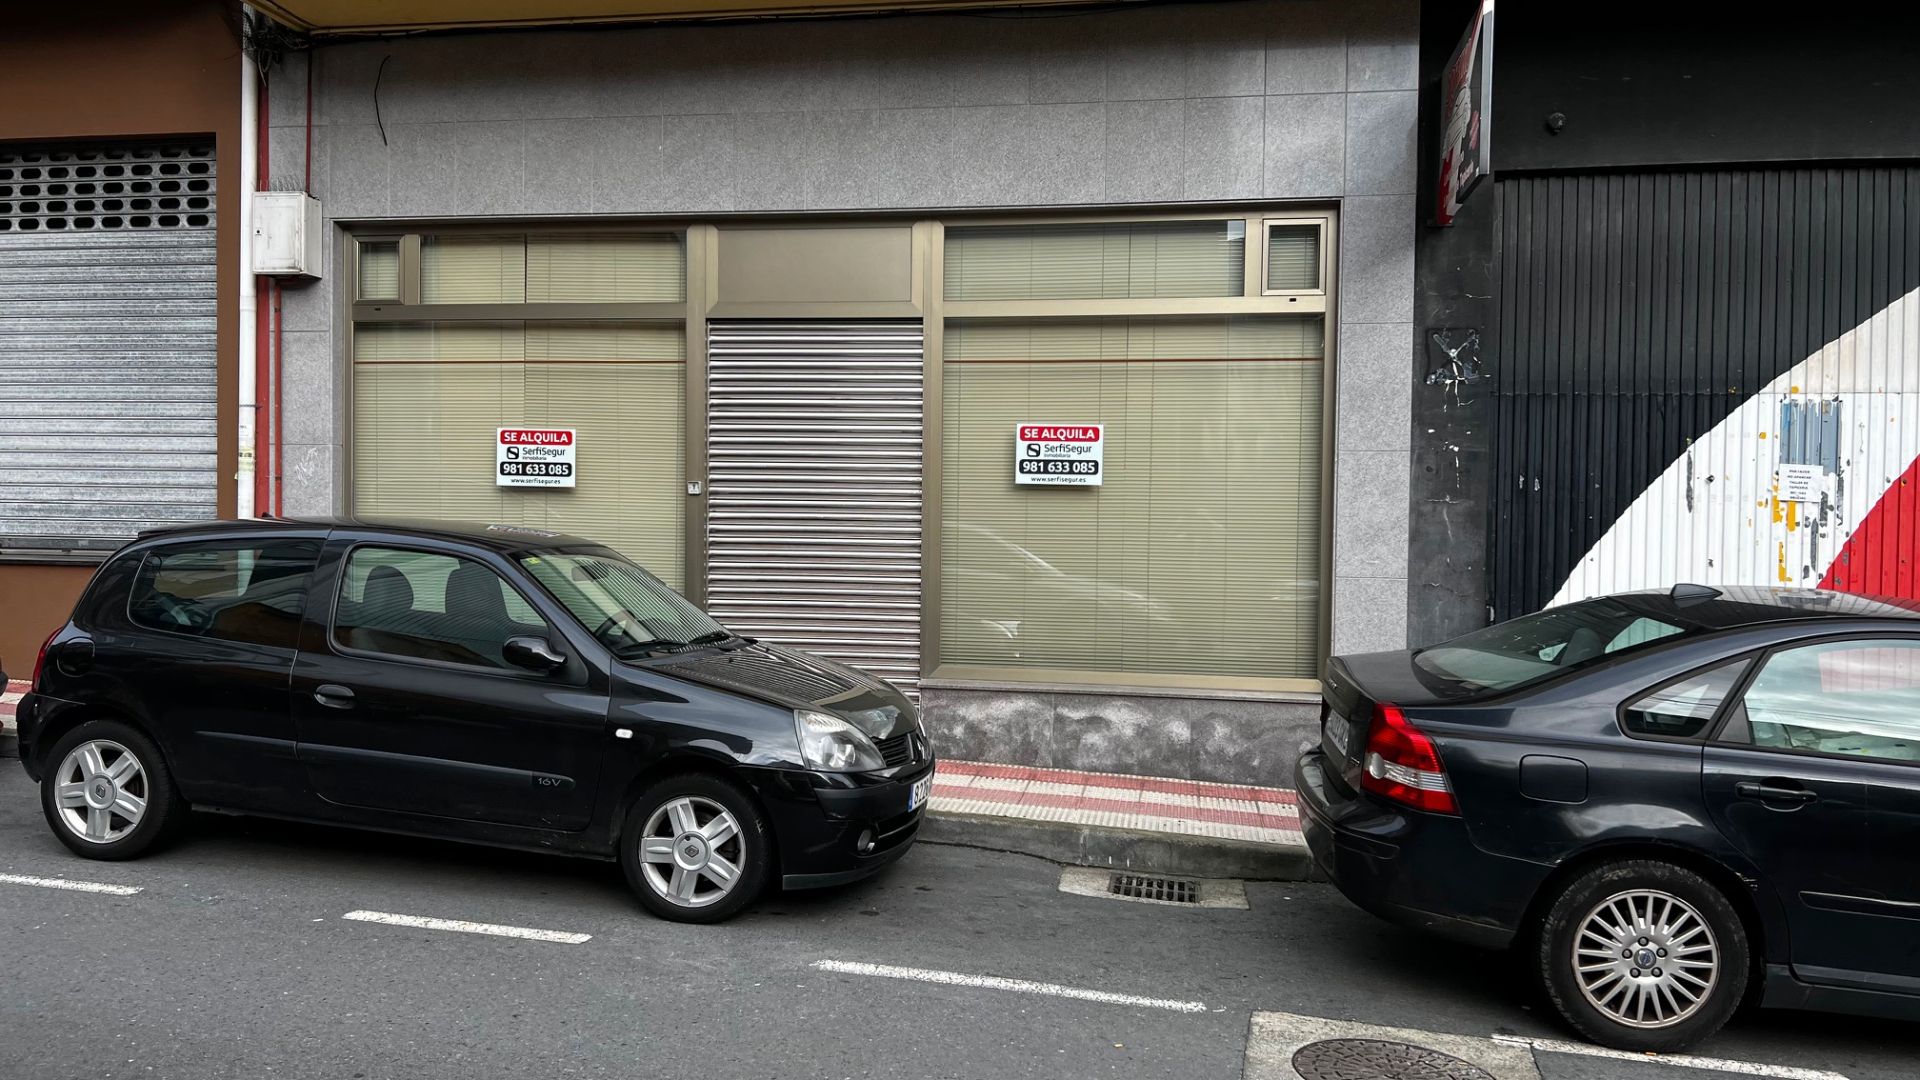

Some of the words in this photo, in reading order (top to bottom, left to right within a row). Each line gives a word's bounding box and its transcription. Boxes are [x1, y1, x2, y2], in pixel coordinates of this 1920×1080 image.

[504, 432, 518, 441] SE
[519, 432, 568, 444] ALQUILA
[1024, 428, 1039, 438] SE
[1041, 428, 1095, 440] ALQUILA
[522, 446, 566, 457] SerfiSegur
[1044, 443, 1092, 455] SerfiSegur
[503, 463, 522, 474] 981
[525, 464, 546, 474] 633
[548, 464, 569, 475] 085
[1023, 461, 1044, 472] 981
[1047, 462, 1070, 472] 633
[1072, 462, 1095, 473] 085
[538, 777, 561, 786] 16V
